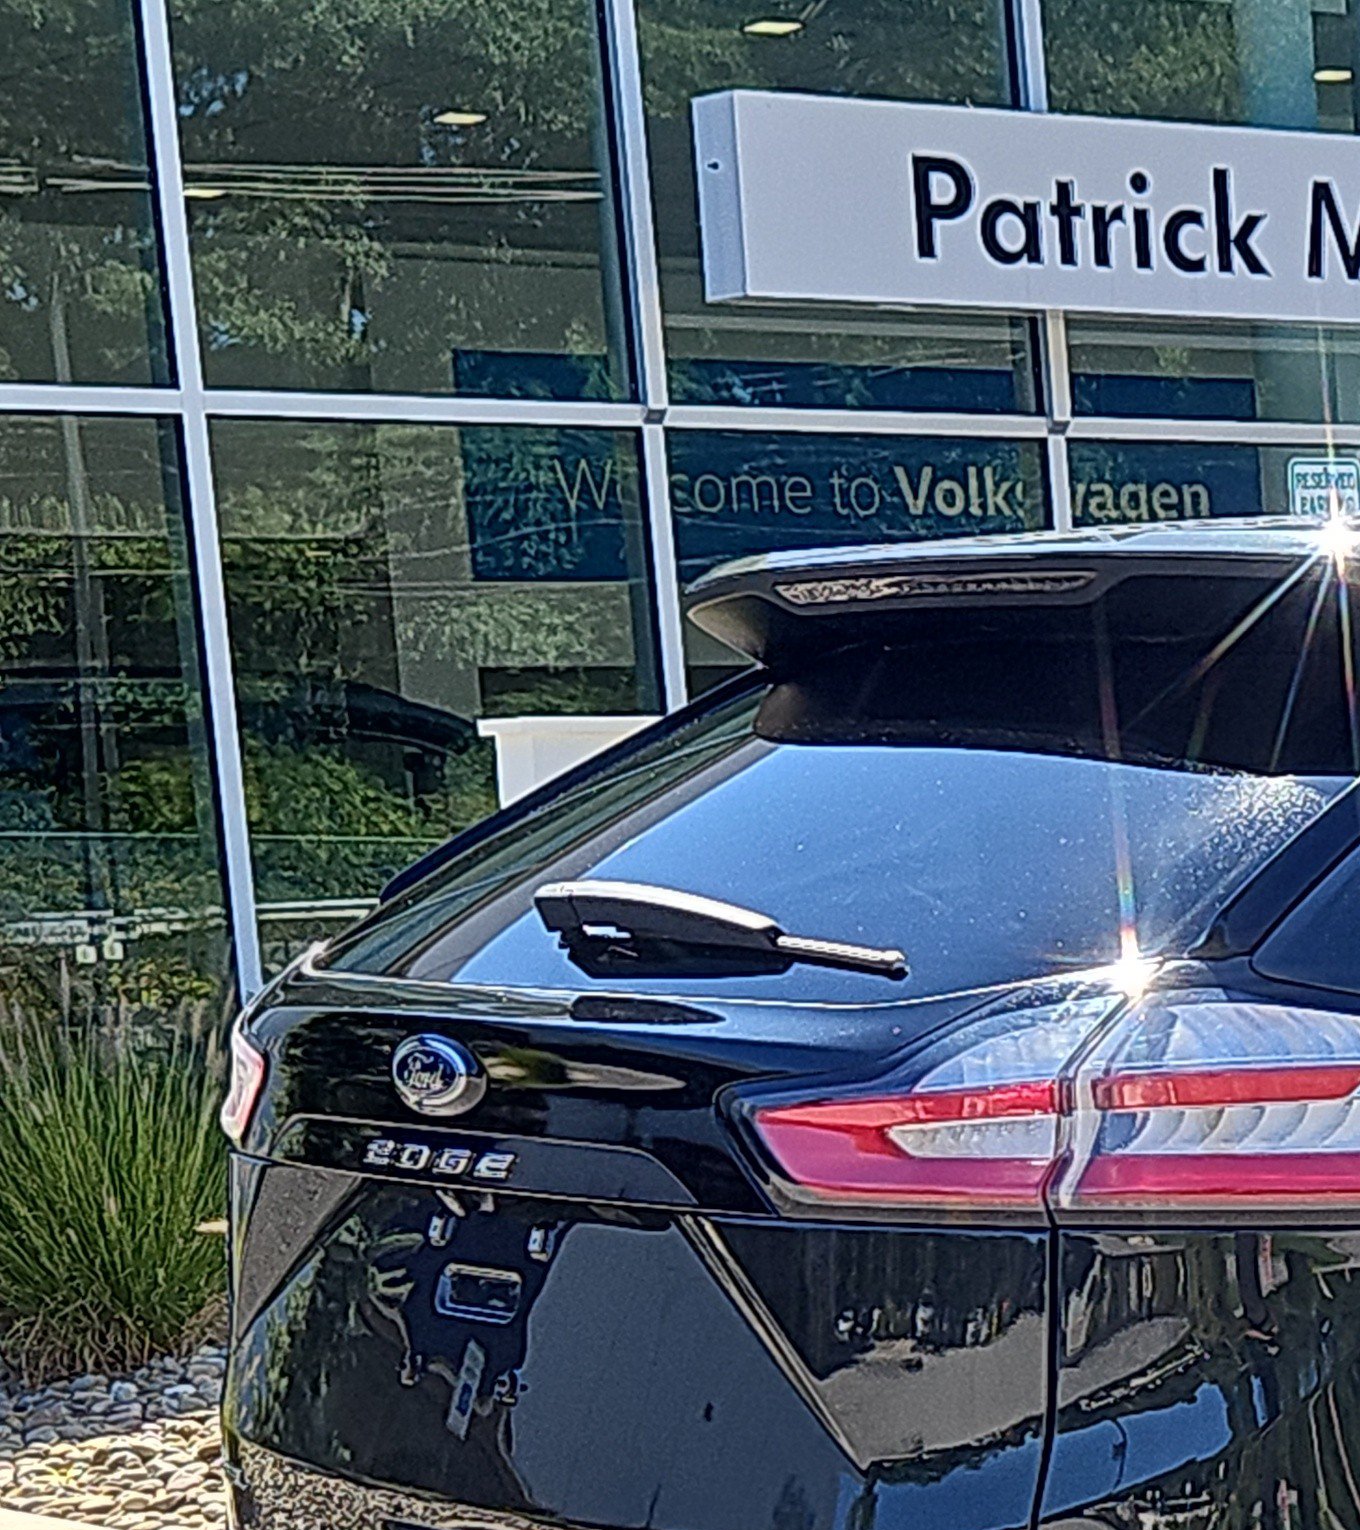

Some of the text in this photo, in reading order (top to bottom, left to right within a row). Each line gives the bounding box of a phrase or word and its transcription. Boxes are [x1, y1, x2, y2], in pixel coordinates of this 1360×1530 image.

[911, 152, 1272, 279] Patrick
[552, 457, 1211, 521] Wcome to Volkagen
[362, 1138, 517, 1181] EDGE
